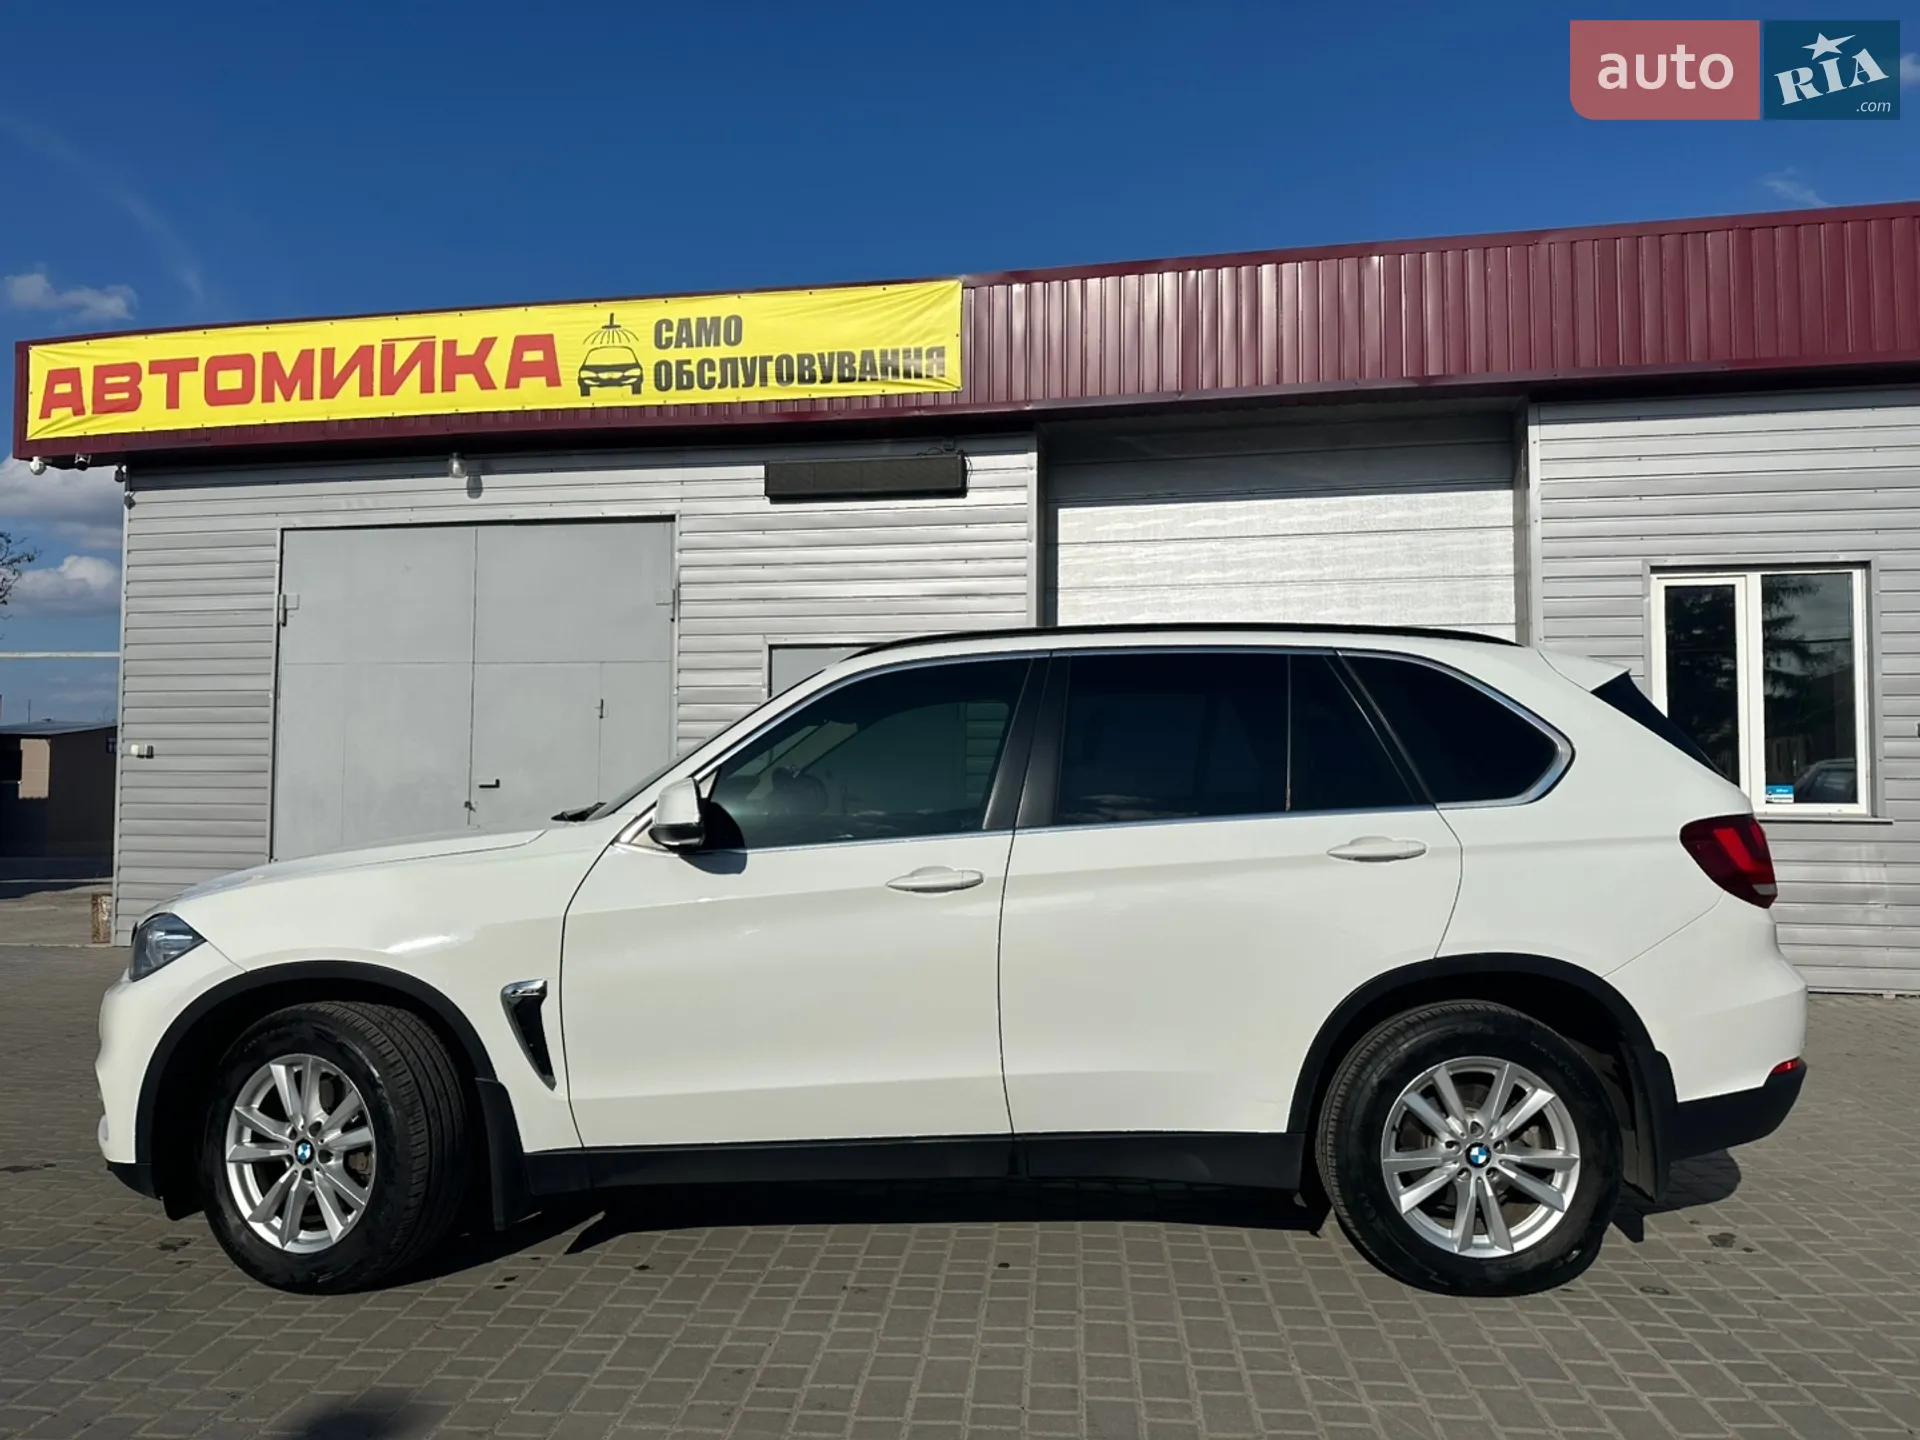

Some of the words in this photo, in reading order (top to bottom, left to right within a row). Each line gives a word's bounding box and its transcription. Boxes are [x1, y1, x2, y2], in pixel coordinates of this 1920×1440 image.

[653, 314, 743, 350] САМО
[39, 333, 562, 420] АВТОМИЙКА
[653, 345, 947, 392] ОБСЛУГОВУВАННЯ
